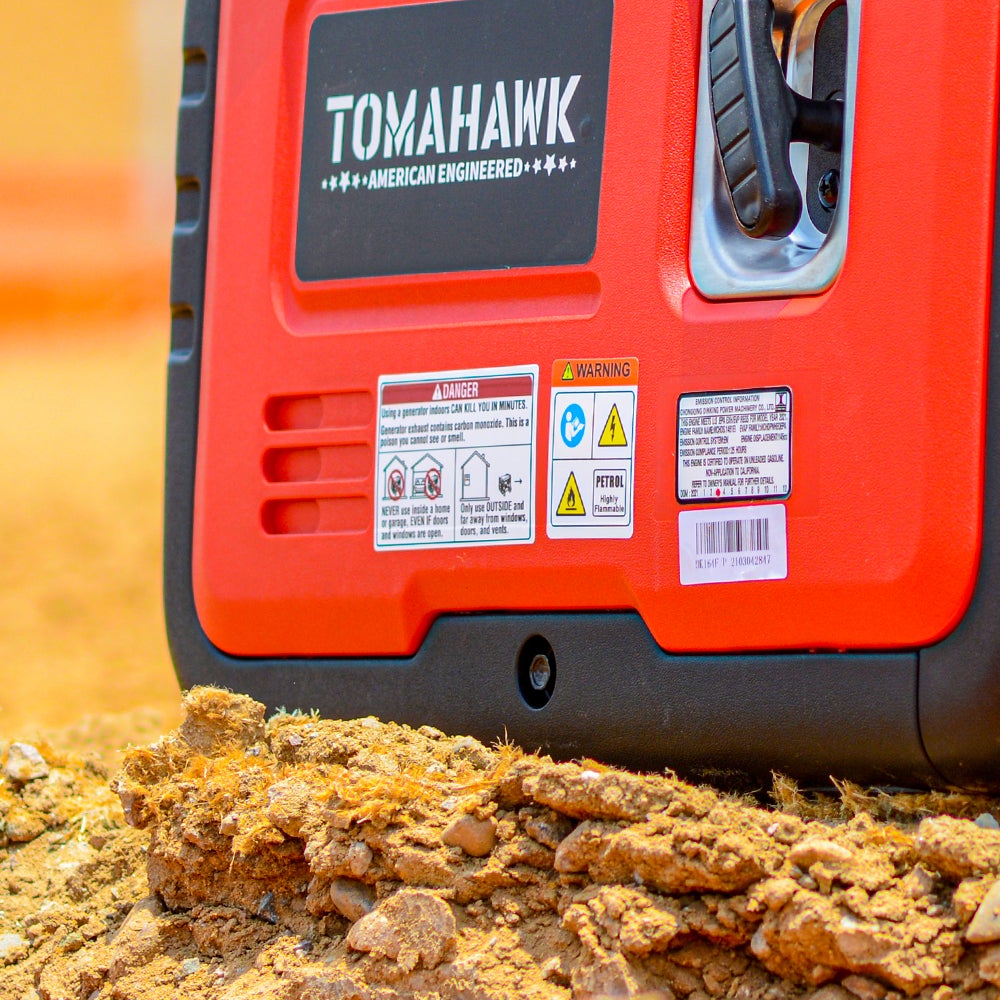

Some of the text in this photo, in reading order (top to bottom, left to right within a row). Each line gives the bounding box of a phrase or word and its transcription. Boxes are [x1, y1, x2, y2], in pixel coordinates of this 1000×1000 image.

[326, 74, 581, 164] TOMAHAWK
[367, 157, 524, 190] AMERICAN ENGINEERED
[576, 361, 631, 378] WARNING
[443, 382, 479, 400] DANGER
[402, 406, 428, 419] generator
[429, 405, 449, 414] indoors
[451, 404, 463, 414] CAN
[464, 403, 476, 412] KILL
[478, 402, 490, 412] YOU
[491, 401, 498, 411] IN
[499, 400, 528, 411] MINUTES.
[381, 425, 407, 435] Generator
[408, 424, 429, 433] exhaust
[430, 422, 453, 432] contains
[455, 420, 473, 430] carbon
[475, 418, 504, 430] monoxide.
[506, 417, 518, 427] This
[519, 416, 524, 427] is
[400, 438, 408, 447] you
[410, 435, 429, 444] cannot
[430, 435, 439, 444] see
[441, 435, 447, 443] or
[596, 475, 624, 488] PETROL
[600, 494, 619, 505] Highly
[382, 505, 400, 516] NEVER
[401, 507, 410, 515] use
[412, 504, 428, 514] inside
[435, 504, 450, 513] home
[461, 500, 524, 515] Only use OUTSIDE and
[595, 504, 624, 512] Flammable
[410, 516, 425, 526] EVEN
[426, 515, 431, 525] IF
[433, 515, 448, 525] doors
[470, 516, 484, 526] away
[486, 514, 499, 523] from
[381, 530, 391, 540] and
[393, 529, 416, 539] windows
[417, 530, 426, 538] are
[480, 525, 491, 535] and
